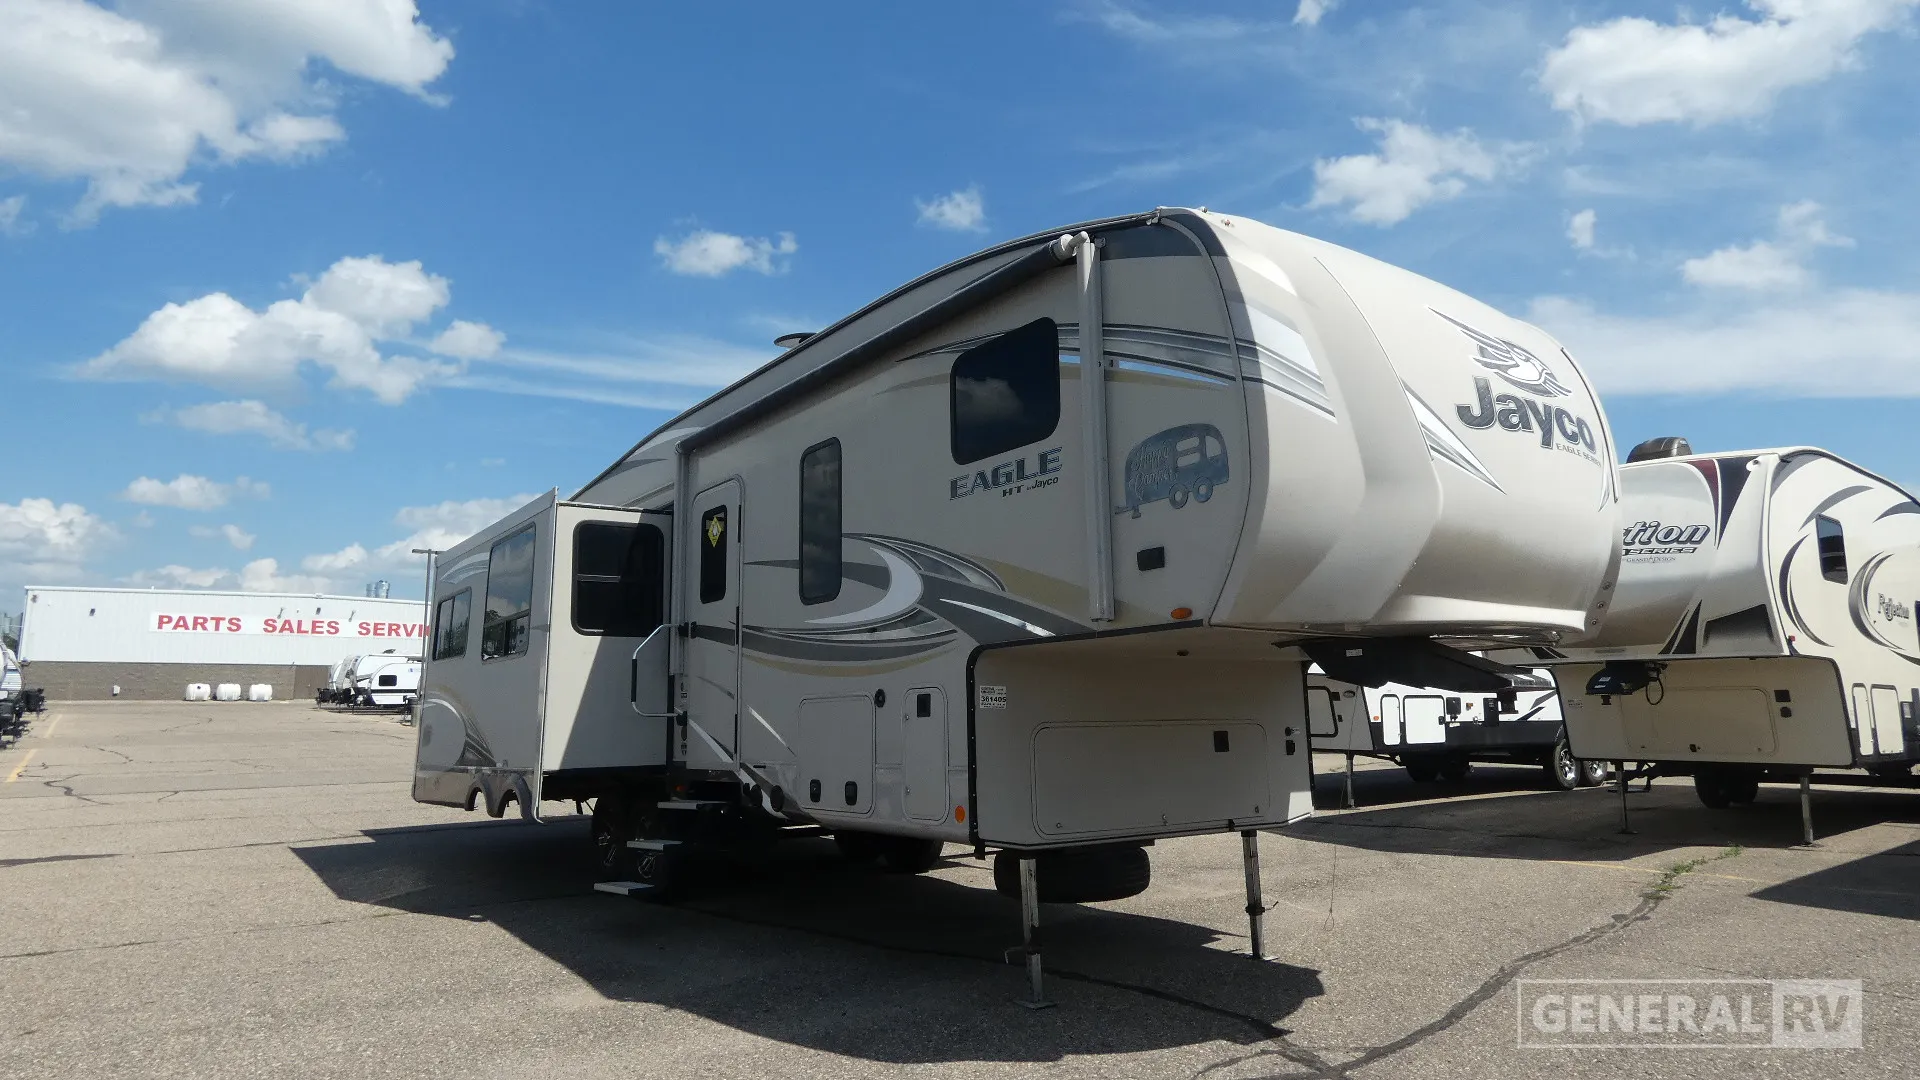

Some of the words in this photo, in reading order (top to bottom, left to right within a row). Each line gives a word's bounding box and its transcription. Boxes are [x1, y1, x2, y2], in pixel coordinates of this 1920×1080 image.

[1455, 375, 1597, 454] Jayco
[1556, 443, 1582, 457] EAGLE
[949, 447, 1063, 500] EAGLE
[1002, 485, 1024, 497] HT
[1033, 477, 1059, 489] Jayco
[1622, 520, 1711, 546] tion
[1626, 547, 1697, 556] SERIES
[157, 614, 242, 632] PARTS
[262, 618, 340, 635] SALES
